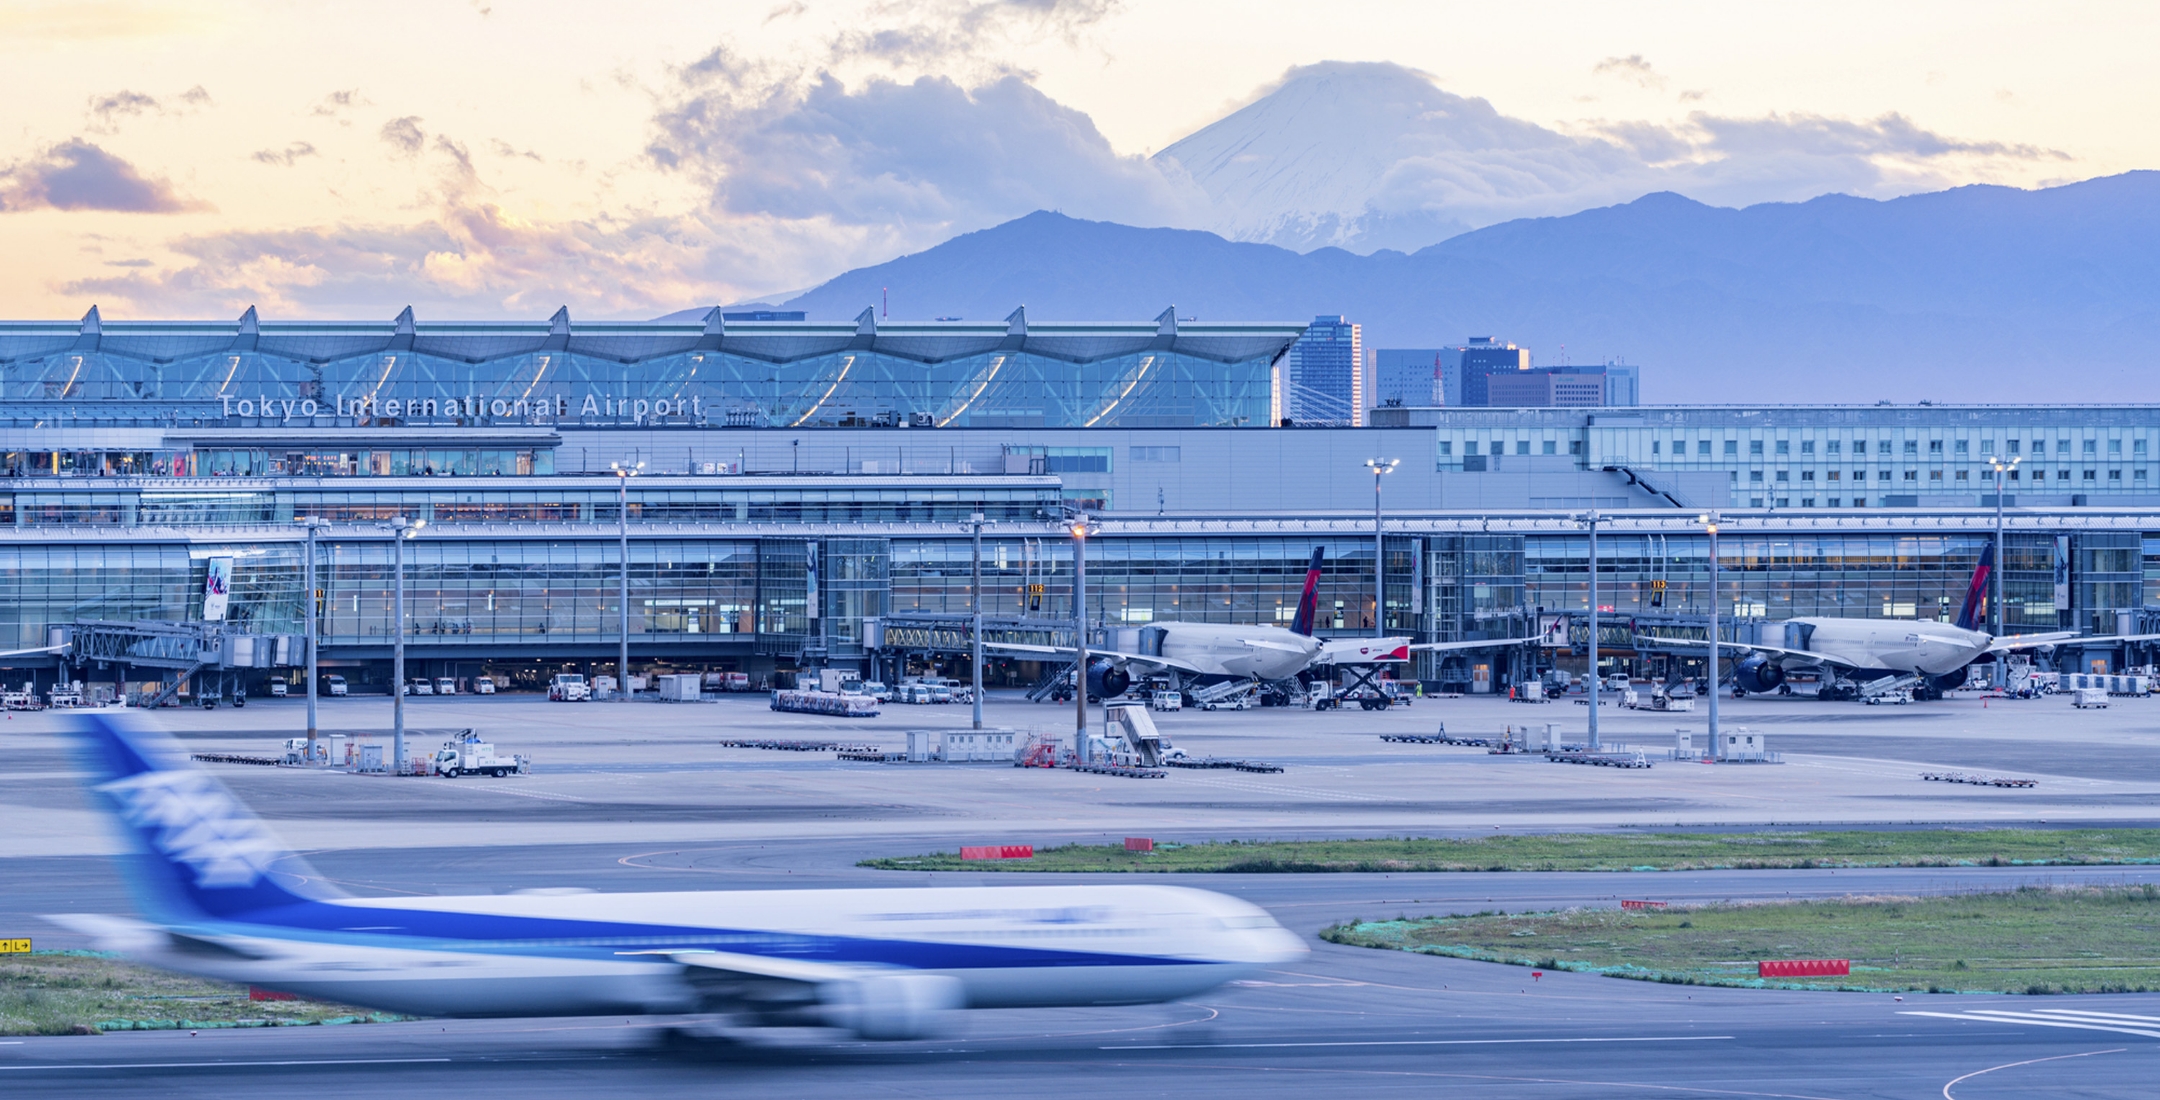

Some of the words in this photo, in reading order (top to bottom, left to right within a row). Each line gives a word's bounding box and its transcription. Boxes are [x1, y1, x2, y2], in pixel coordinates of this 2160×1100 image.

[217, 394, 318, 421] Tokyo
[336, 394, 561, 417] International
[580, 394, 701, 421] Airport
[14, 941, 20, 951] L
